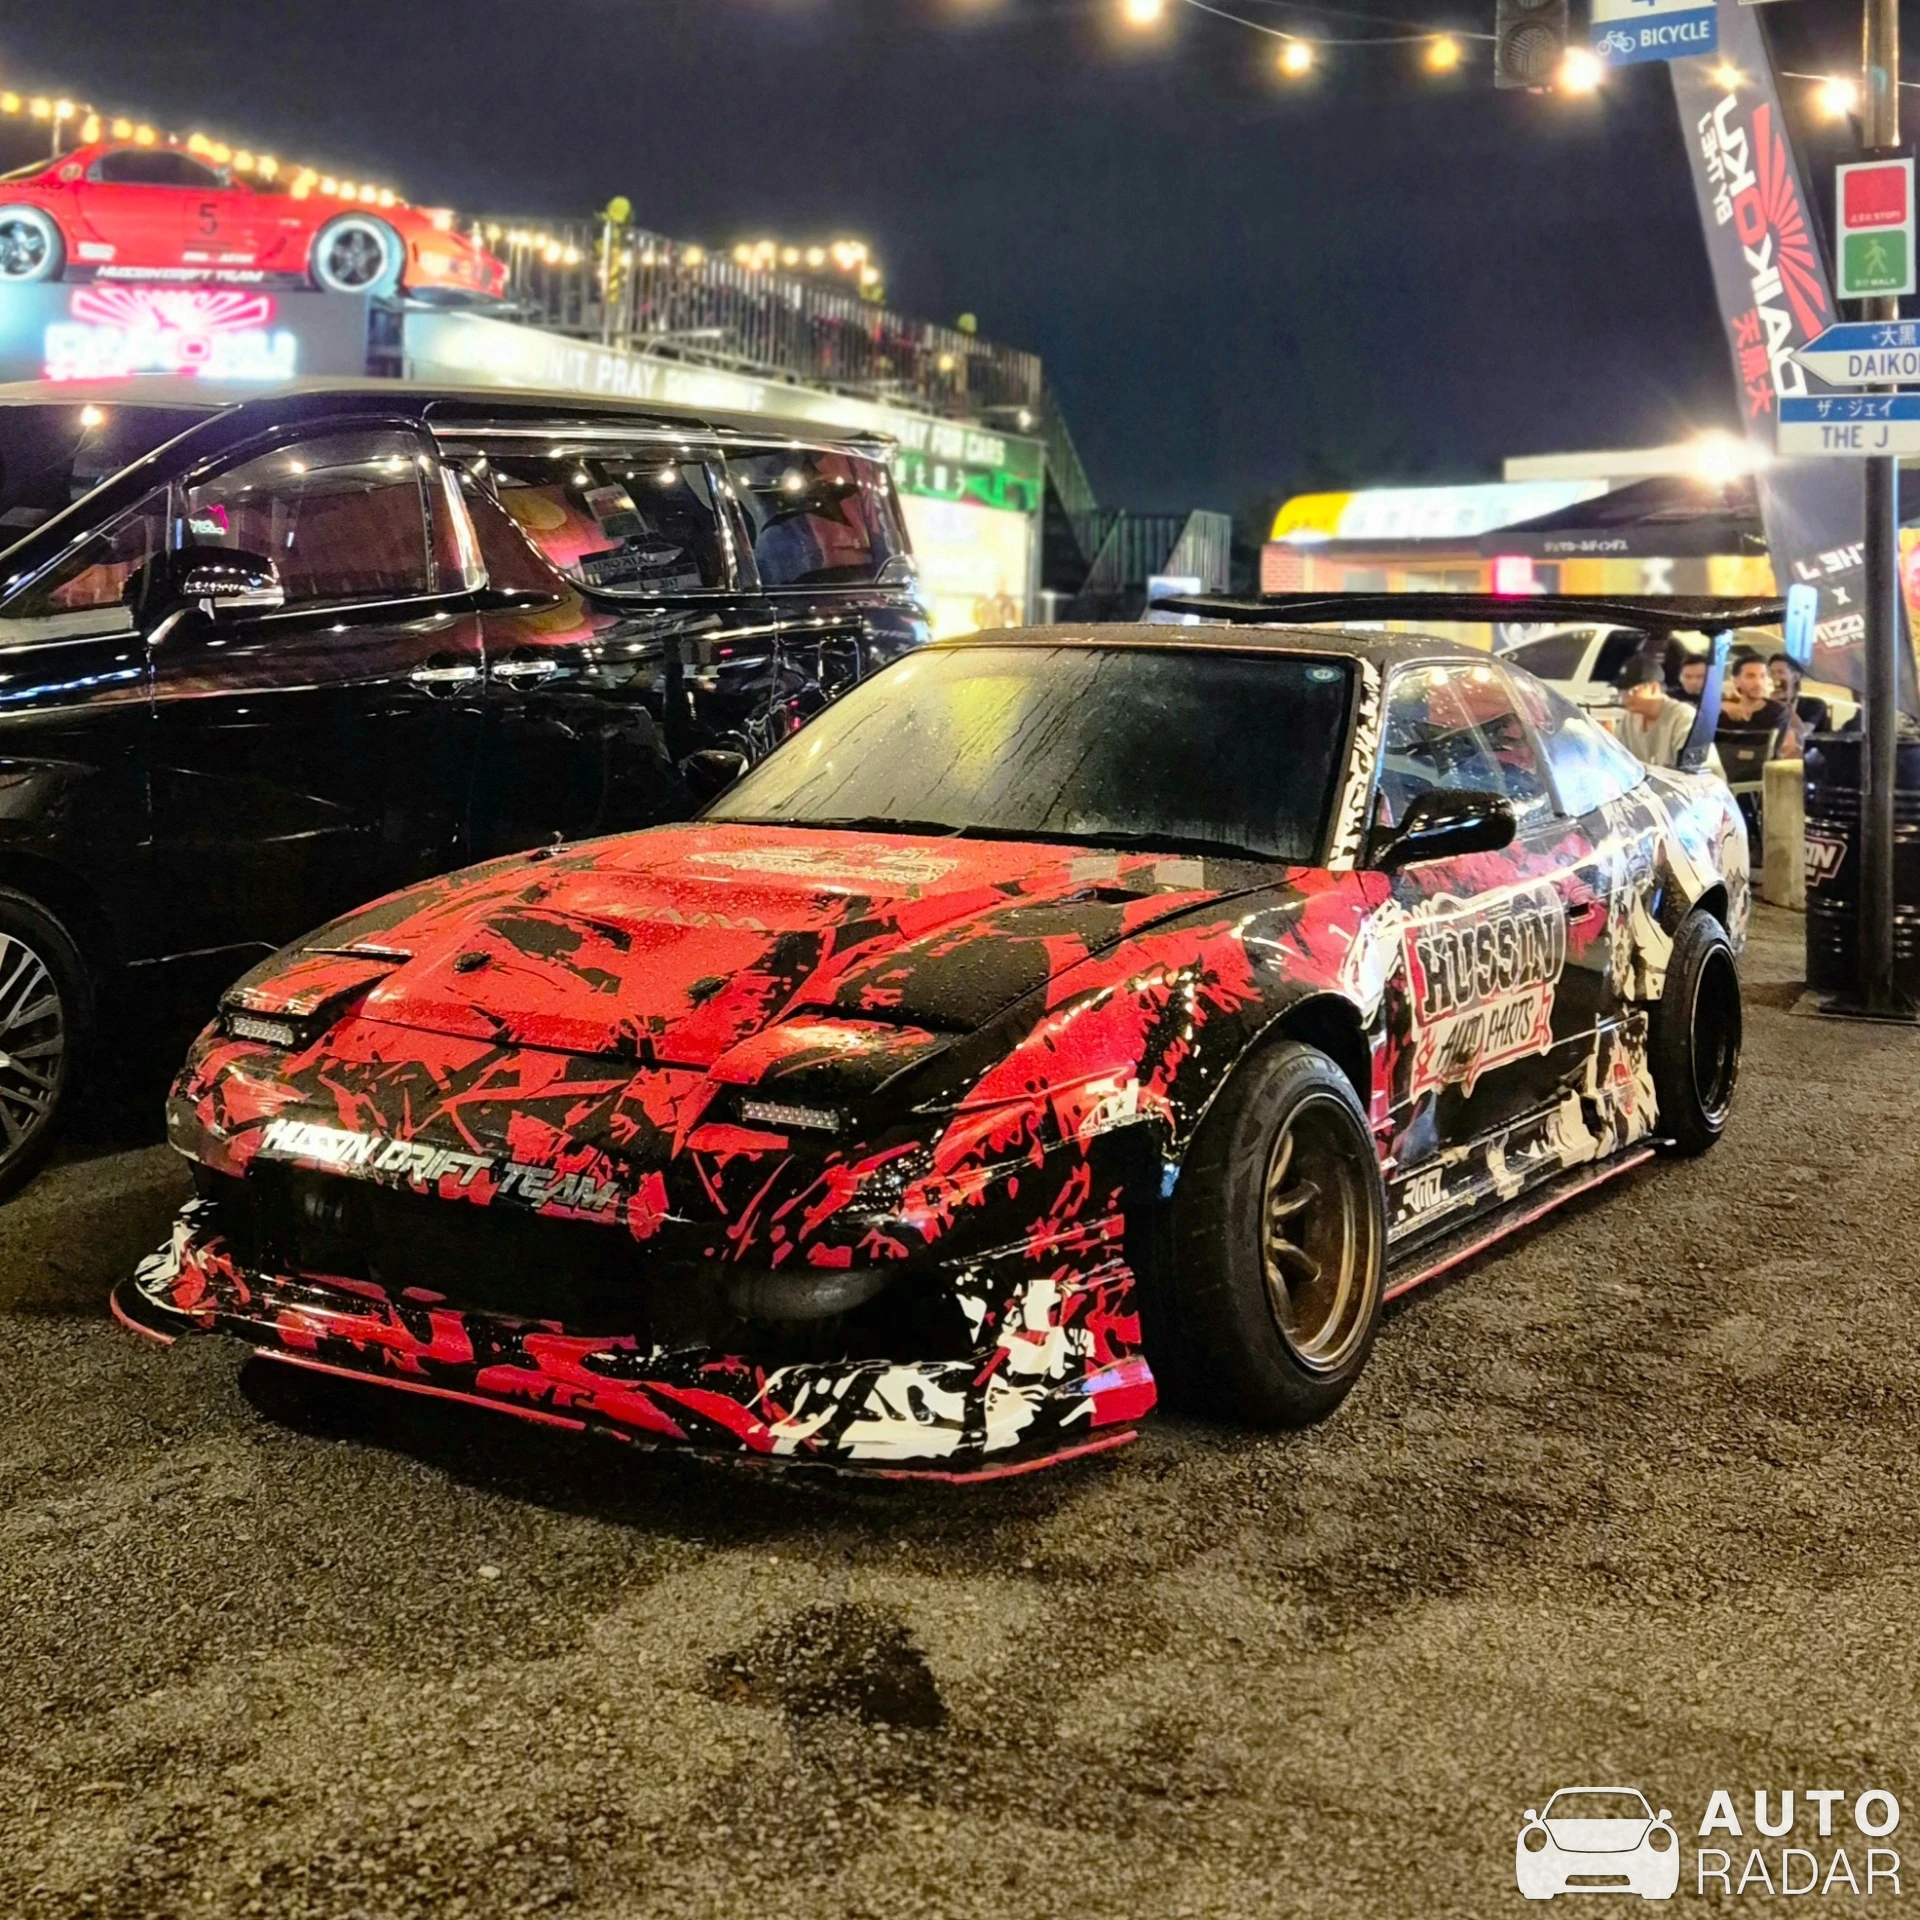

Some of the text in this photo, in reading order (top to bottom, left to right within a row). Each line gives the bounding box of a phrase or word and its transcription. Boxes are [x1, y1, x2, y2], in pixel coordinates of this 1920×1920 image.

[1640, 20, 1710, 48] BICYCLE
[199, 202, 218, 237] 5
[1848, 351, 1920, 378] DAIKO
[1821, 424, 1889, 450] THE J
[376, 1140, 495, 1184] DRIFT
[501, 1162, 620, 1209] TEAM
